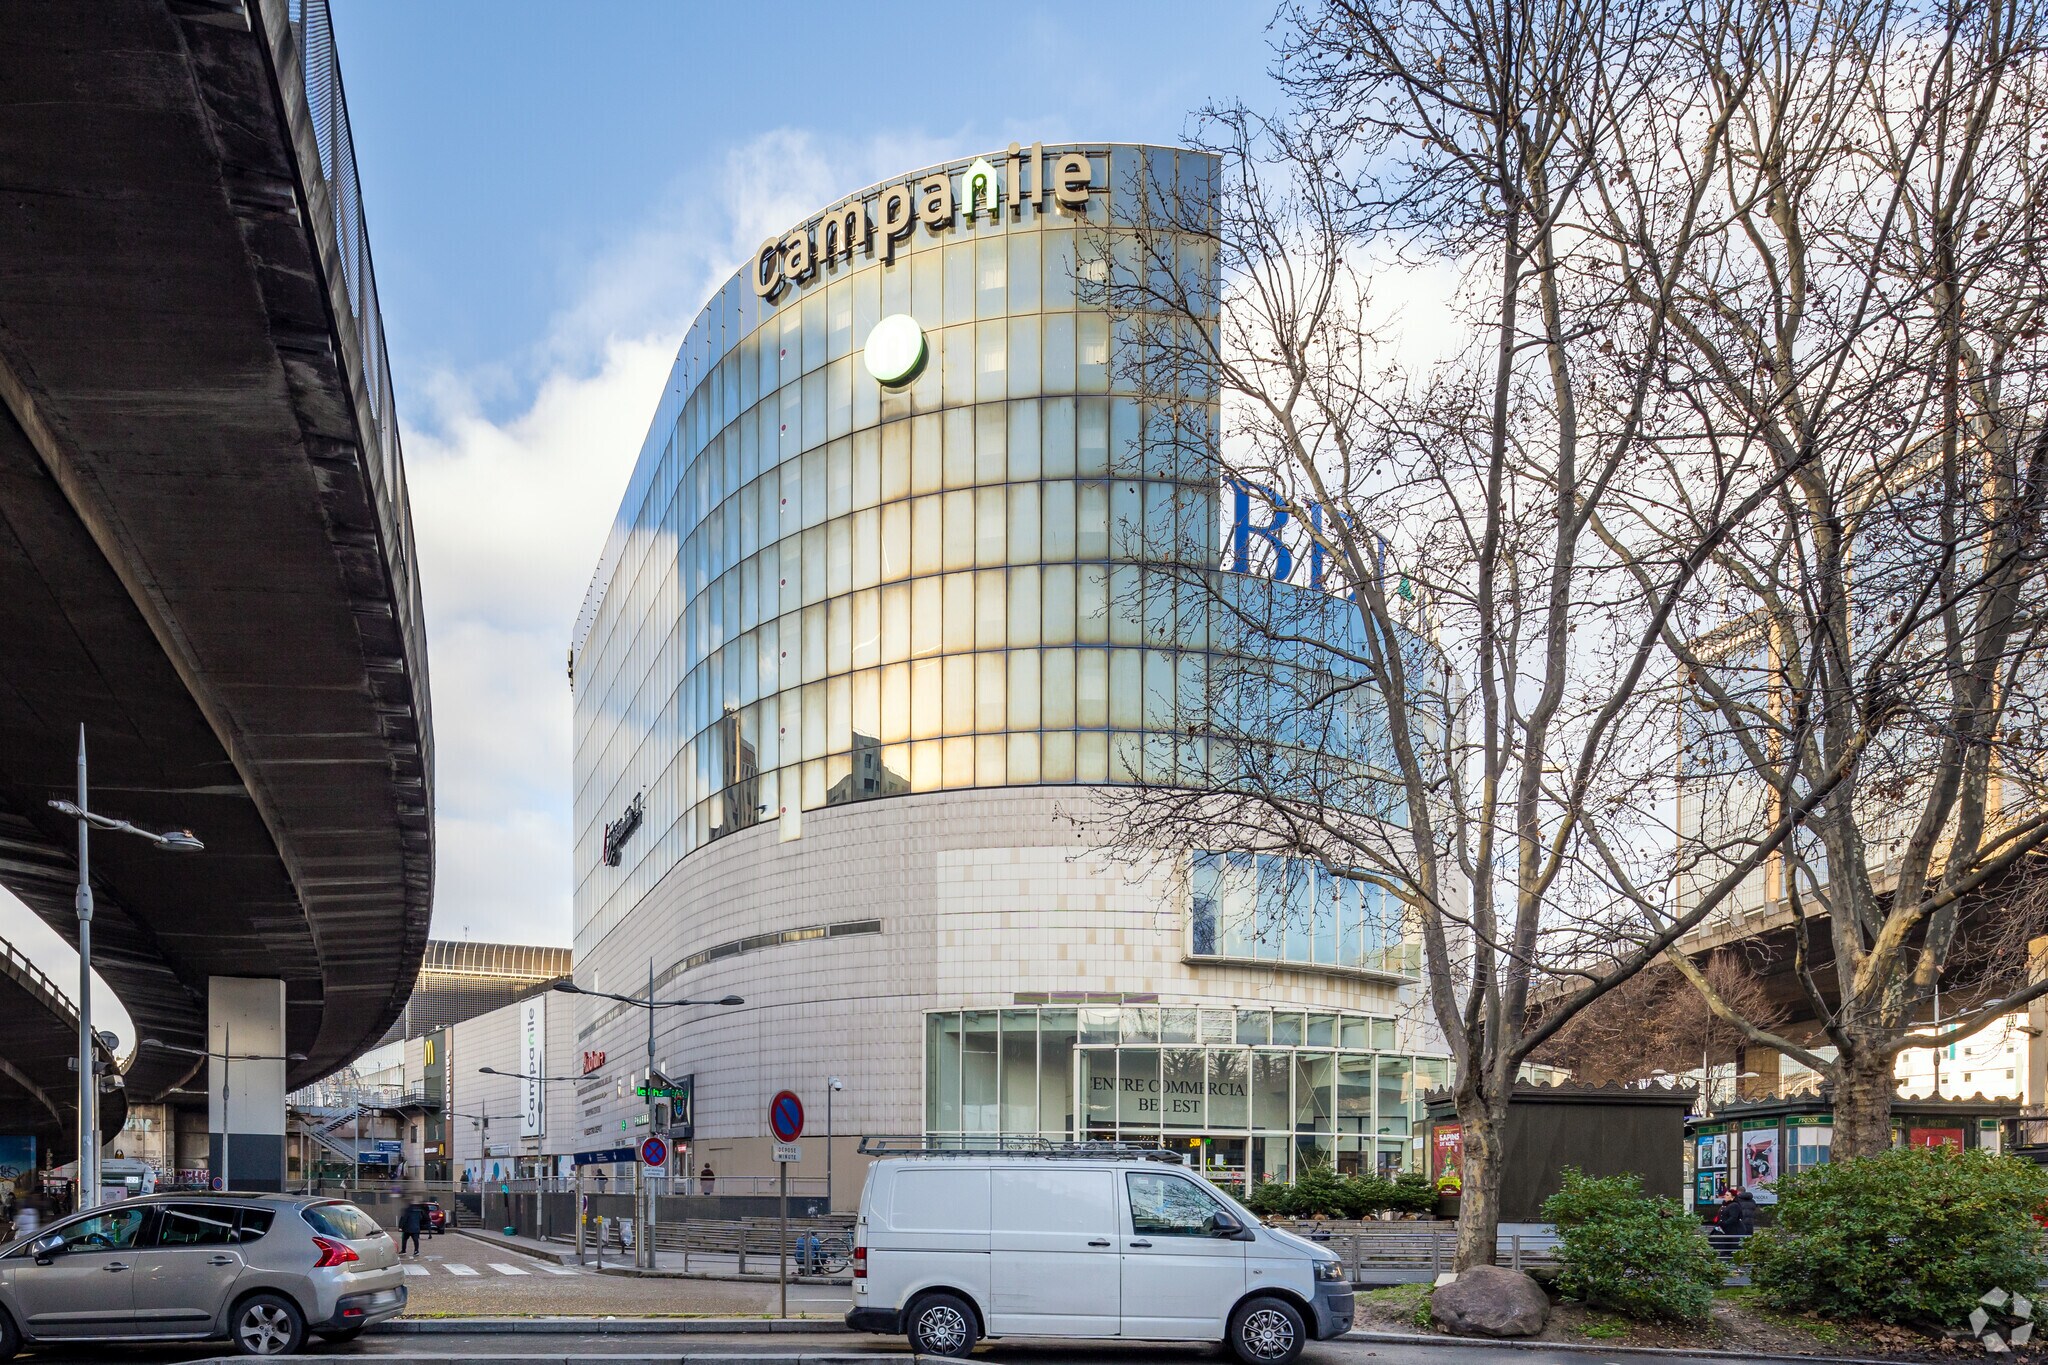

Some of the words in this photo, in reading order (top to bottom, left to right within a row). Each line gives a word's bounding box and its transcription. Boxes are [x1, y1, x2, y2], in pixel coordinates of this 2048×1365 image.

[752, 141, 1092, 298] Campanile
[527, 1007, 536, 1128] Campanile
[1091, 1077, 1145, 1092] ENTRE
[1172, 1099, 1201, 1113] EST
[1439, 1133, 1460, 1141] SAPINS
